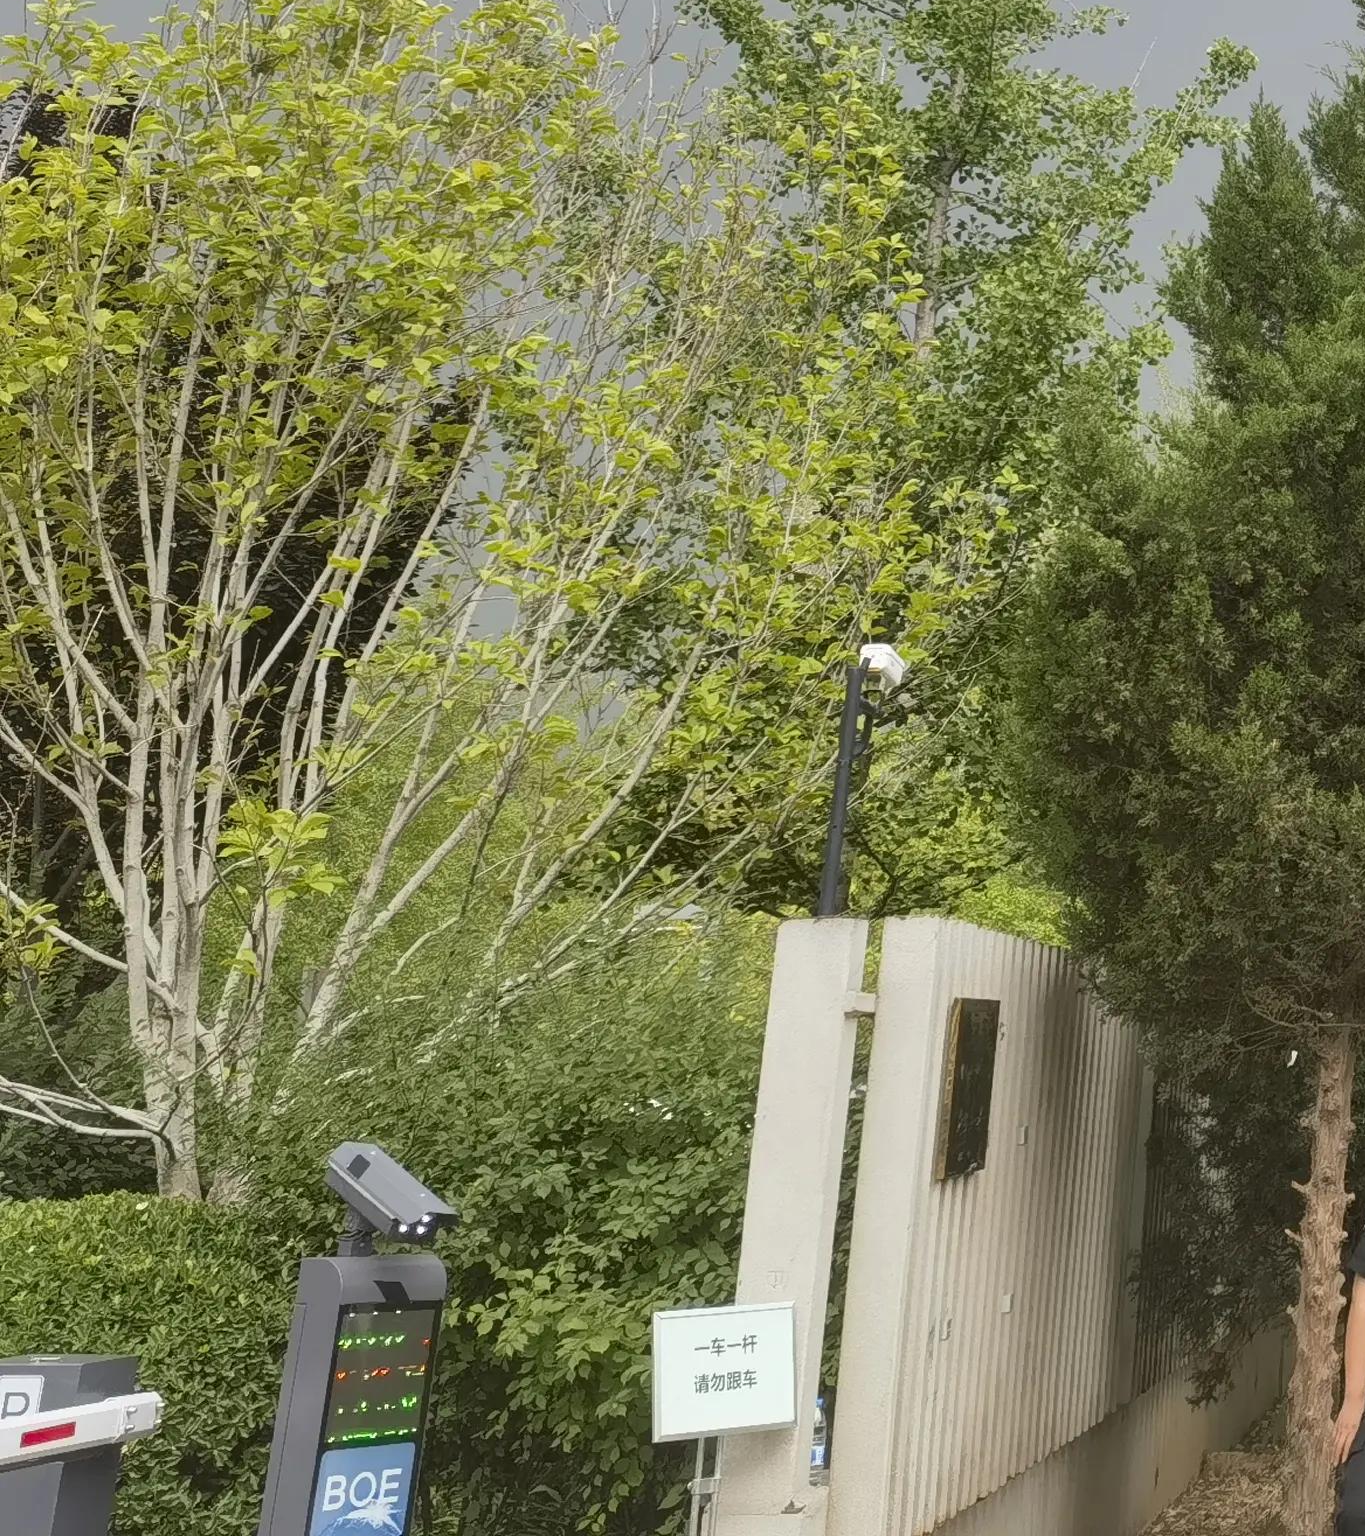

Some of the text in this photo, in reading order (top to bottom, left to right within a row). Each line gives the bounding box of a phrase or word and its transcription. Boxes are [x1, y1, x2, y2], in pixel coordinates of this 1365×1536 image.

[694, 1334, 757, 1356] 一车一杆
[694, 1368, 757, 1395] 请勿跟车
[322, 1467, 403, 1513] BOE
